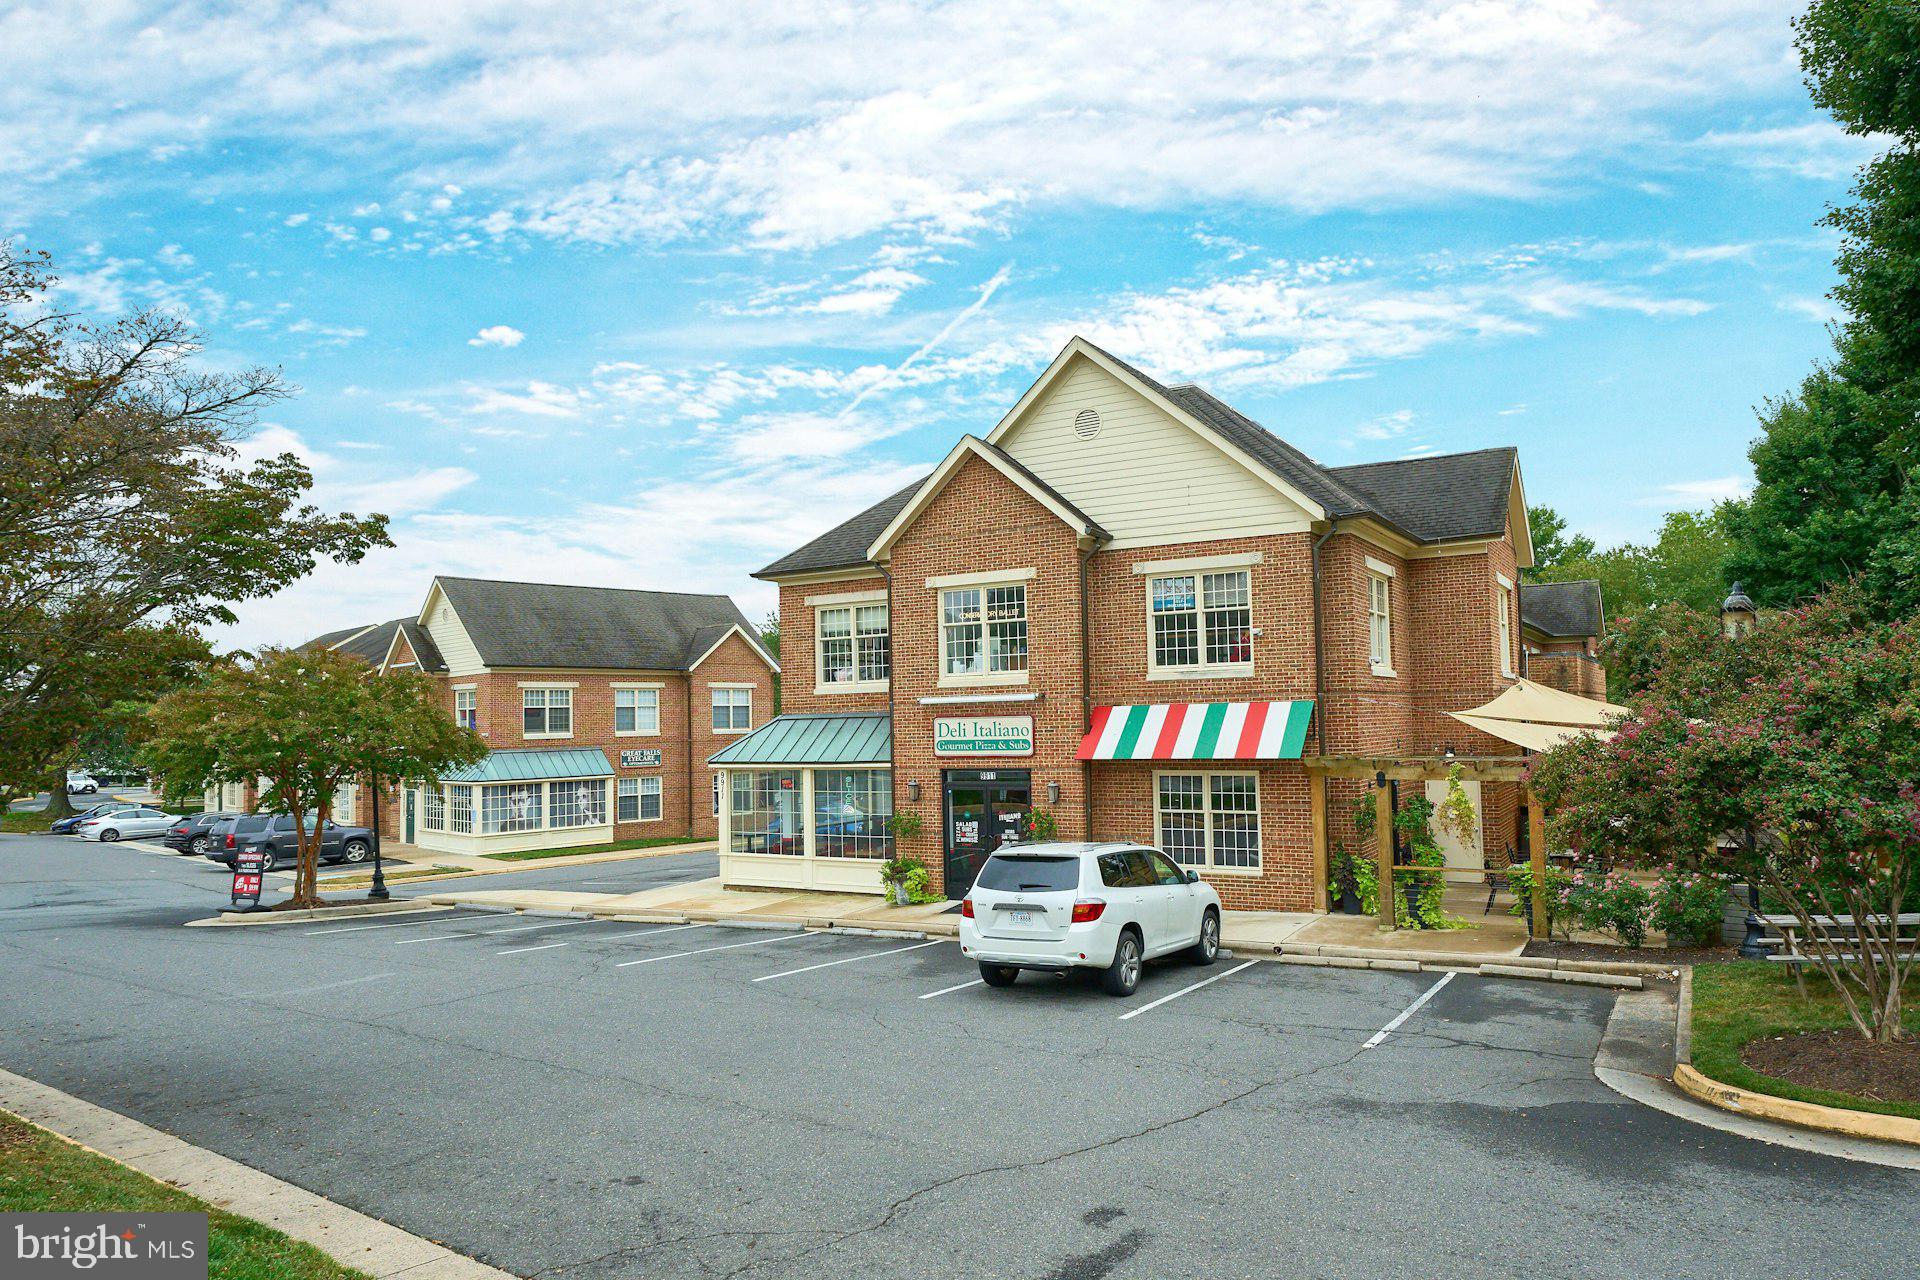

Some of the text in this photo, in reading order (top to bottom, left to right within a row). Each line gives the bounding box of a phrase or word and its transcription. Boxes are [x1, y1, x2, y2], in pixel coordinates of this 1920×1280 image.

[998, 608, 1020, 617] BALLET
[937, 720, 1030, 738] Deli Italiano
[937, 740, 1029, 751] Gourmet Pizza & Subs
